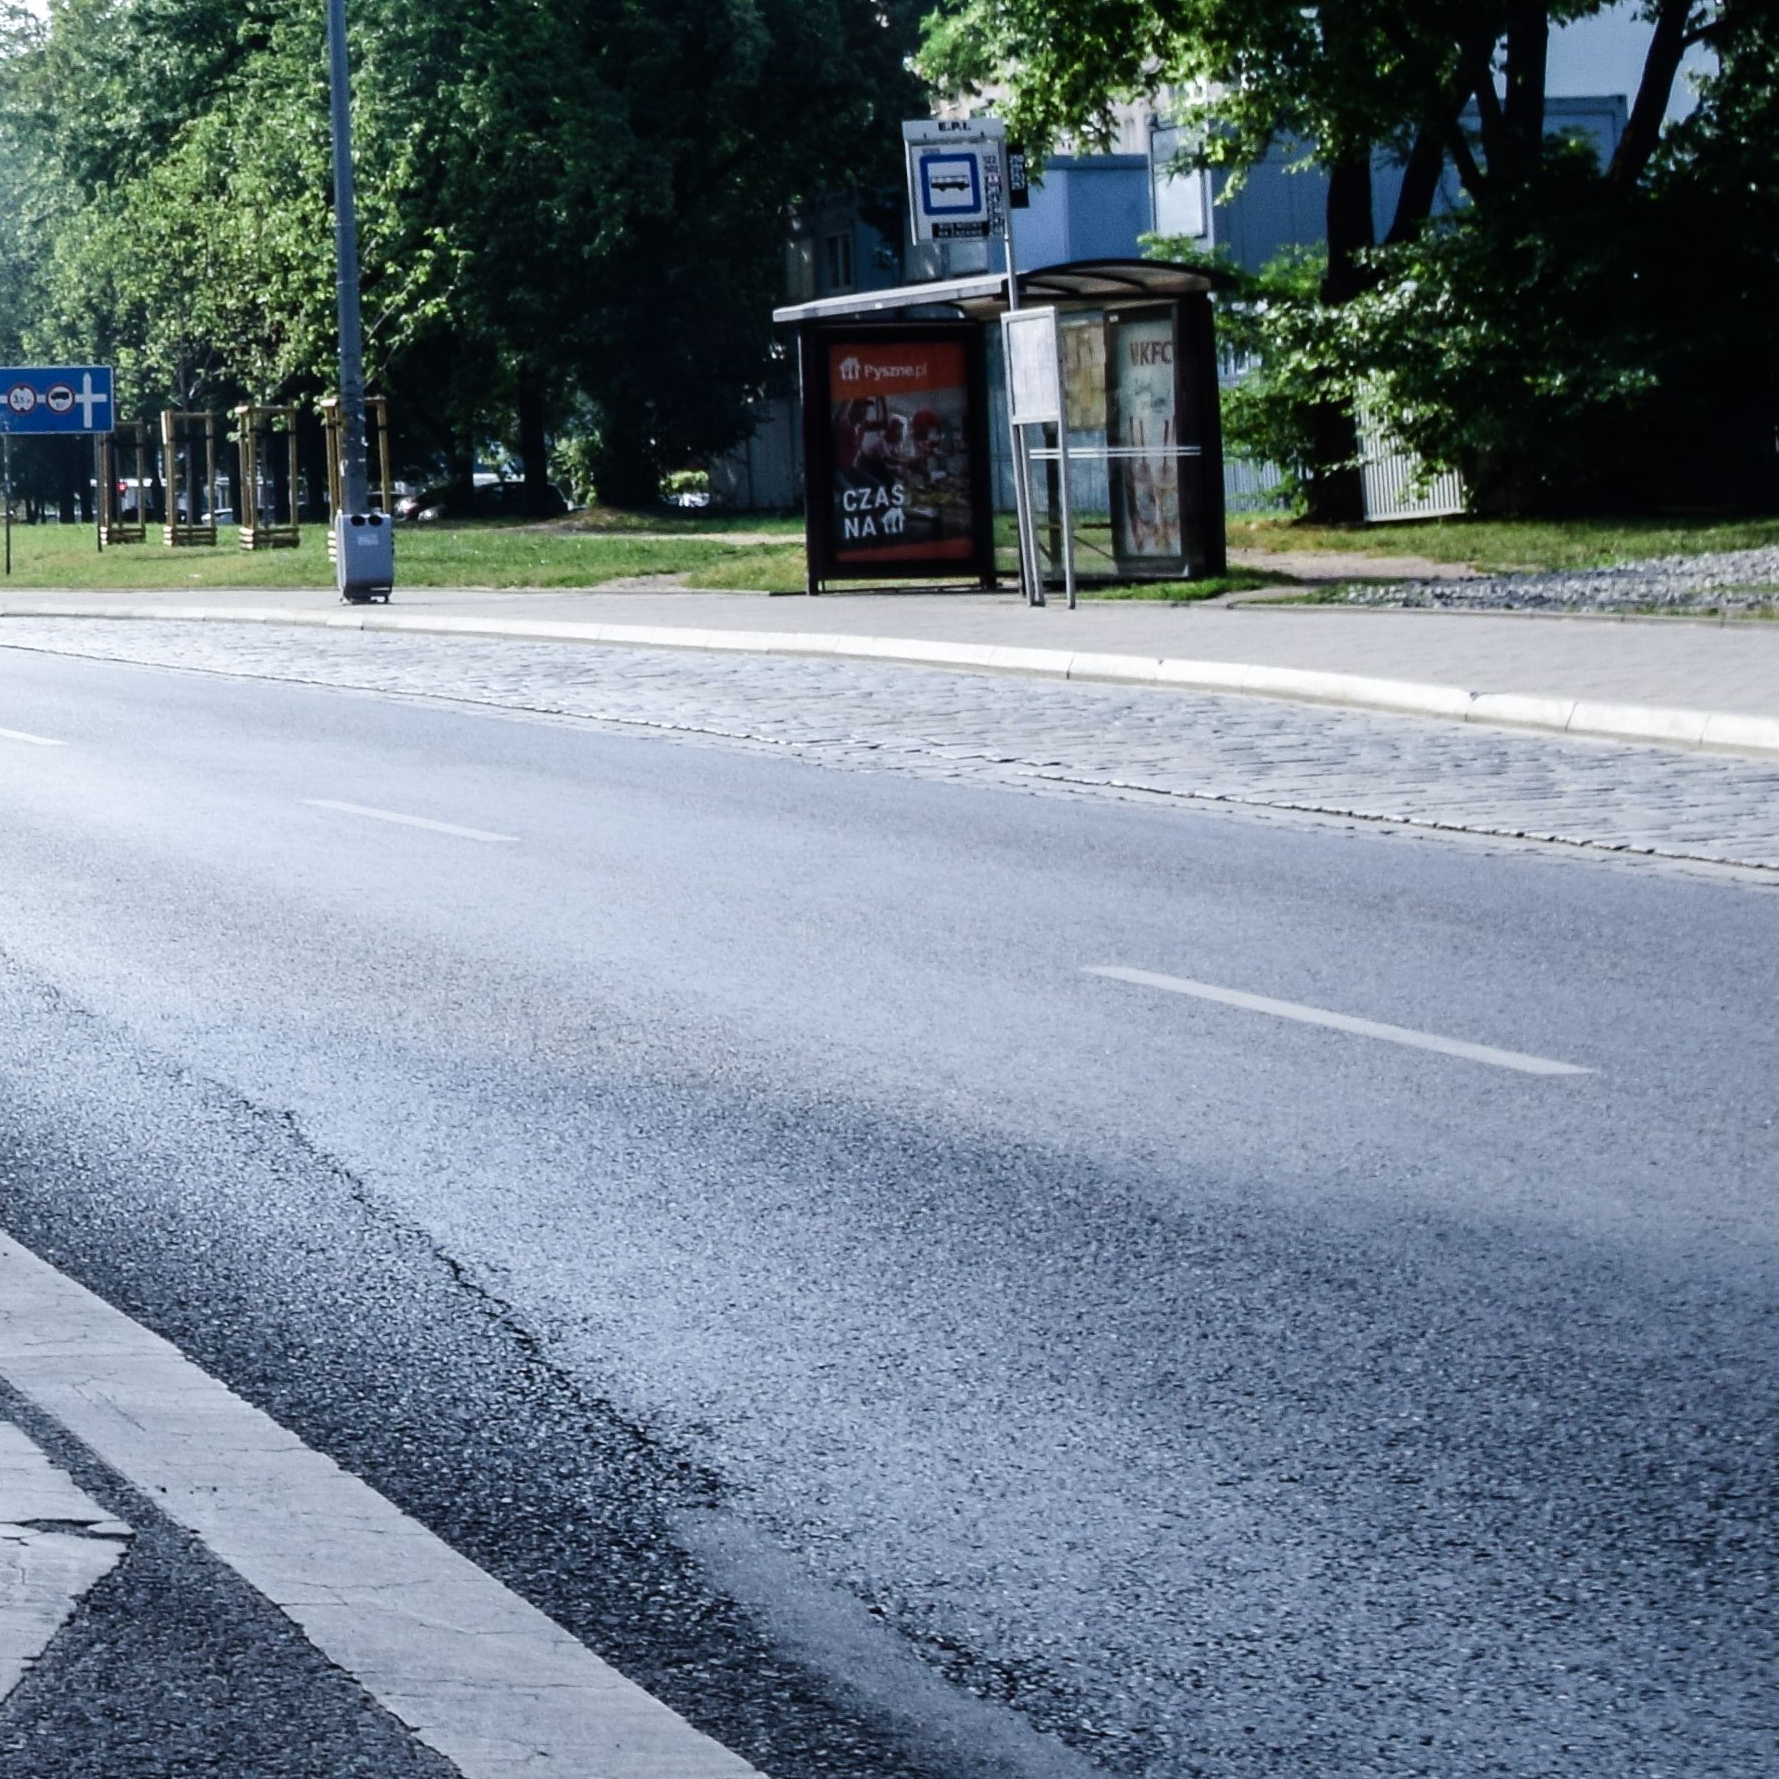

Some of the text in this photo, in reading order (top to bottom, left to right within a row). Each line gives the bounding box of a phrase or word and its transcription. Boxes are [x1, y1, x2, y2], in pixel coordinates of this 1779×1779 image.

[863, 363, 929, 382] Pyszne.pl
[843, 484, 905, 512] CZAS
[843, 514, 877, 540] NA
